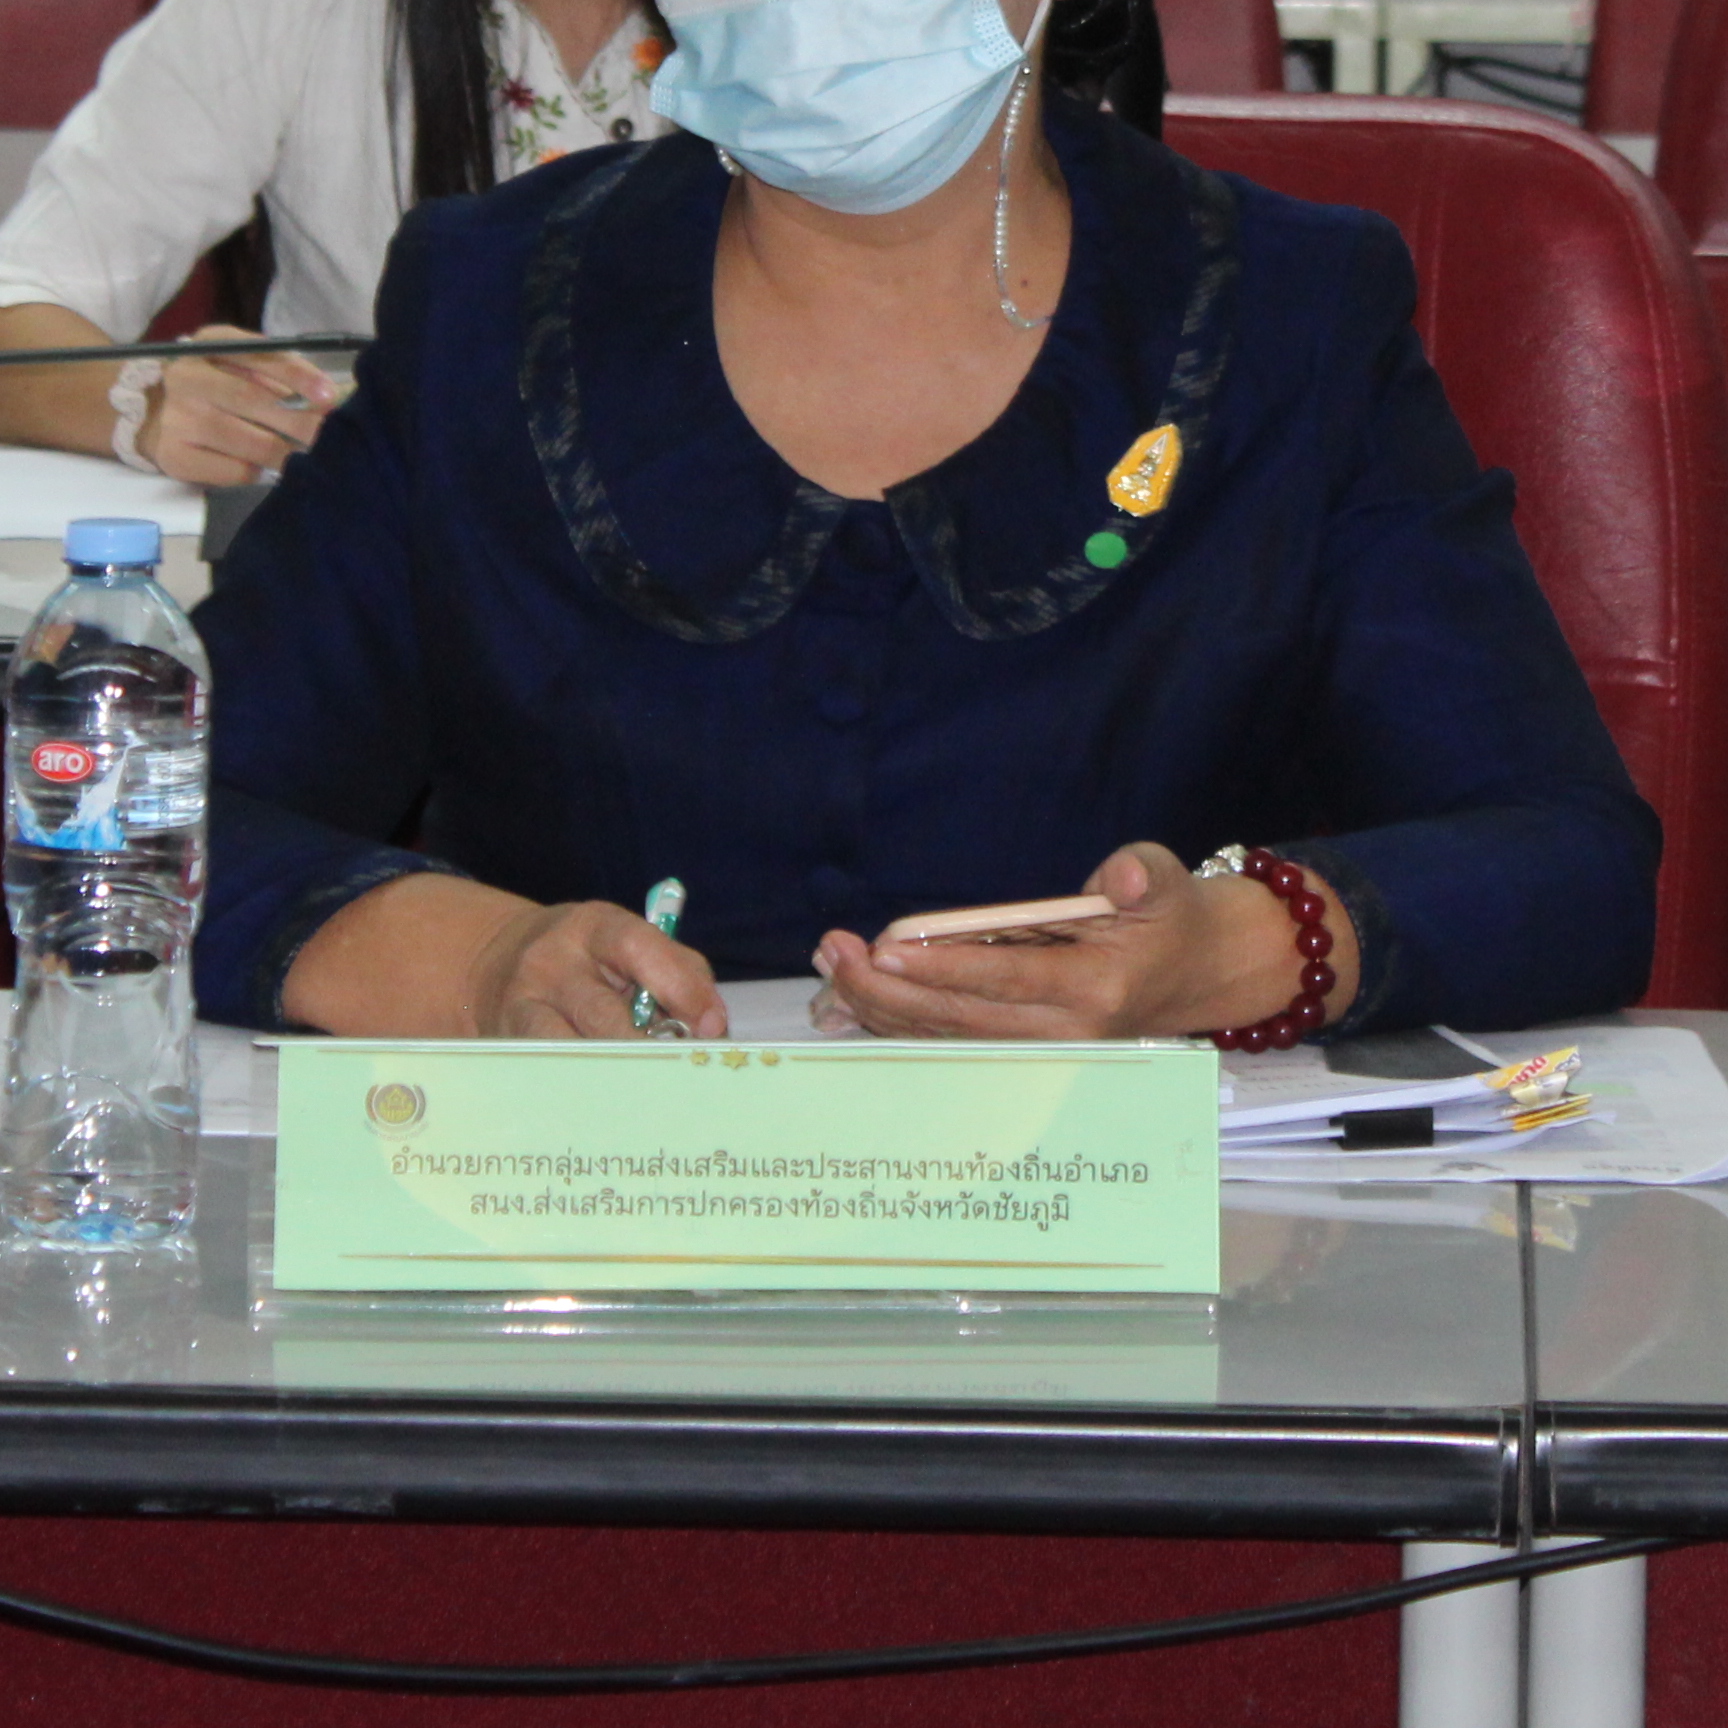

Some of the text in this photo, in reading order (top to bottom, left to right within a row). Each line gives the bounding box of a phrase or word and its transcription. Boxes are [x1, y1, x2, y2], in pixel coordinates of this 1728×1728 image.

[37, 750, 85, 774] aro
[390, 1145, 1150, 1186] อำนวยการกลุ่มงานส่งเสริมและประสานงานท้องถิ่นอำเภอ
[469, 1184, 1071, 1232] สนง.ส่งเสริมการปกครองท้องถิ่นจังหวัดชัยภูมิ
